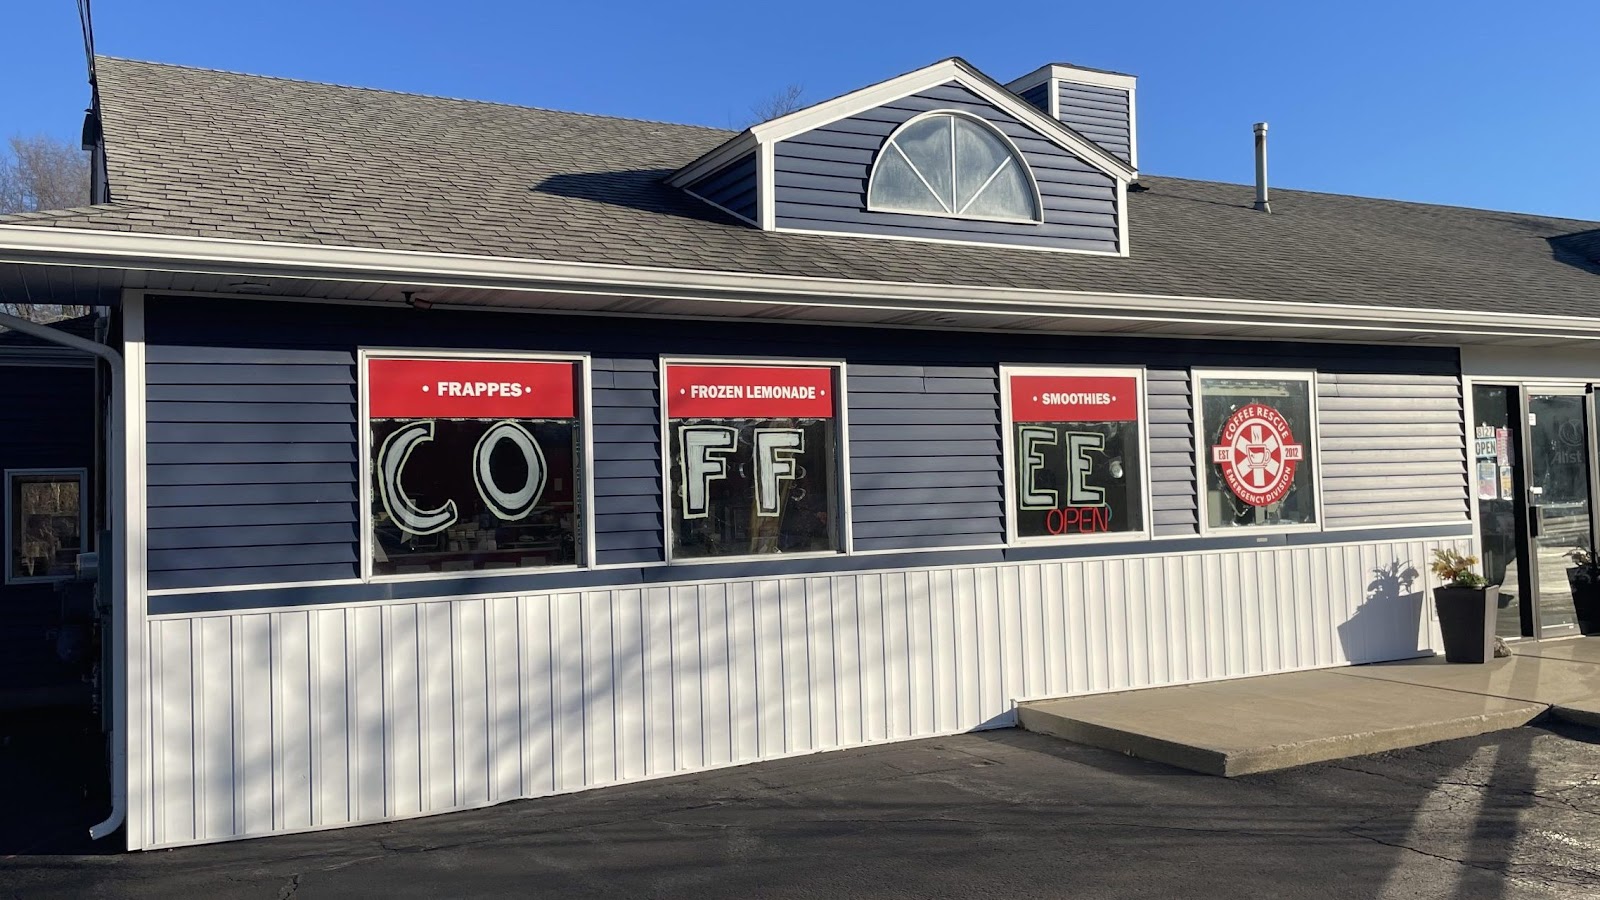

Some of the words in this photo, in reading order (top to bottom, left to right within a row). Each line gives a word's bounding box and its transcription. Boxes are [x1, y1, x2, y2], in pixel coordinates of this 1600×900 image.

[437, 382, 522, 397] FRAPPES
[691, 385, 743, 399] FROZEN
[746, 386, 816, 400] LEMONADE
[1042, 392, 1111, 405] SMOOTHIES
[1225, 407, 1254, 440] COFFEE
[1257, 406, 1289, 439] RESCUE
[1218, 449, 1230, 460] EST
[1285, 447, 1299, 458] 2012
[1475, 441, 1496, 455] OPEN
[1226, 468, 1266, 504] EMERGENCY
[1266, 466, 1291, 503] DIVISION
[1047, 507, 1109, 535] OPEN
